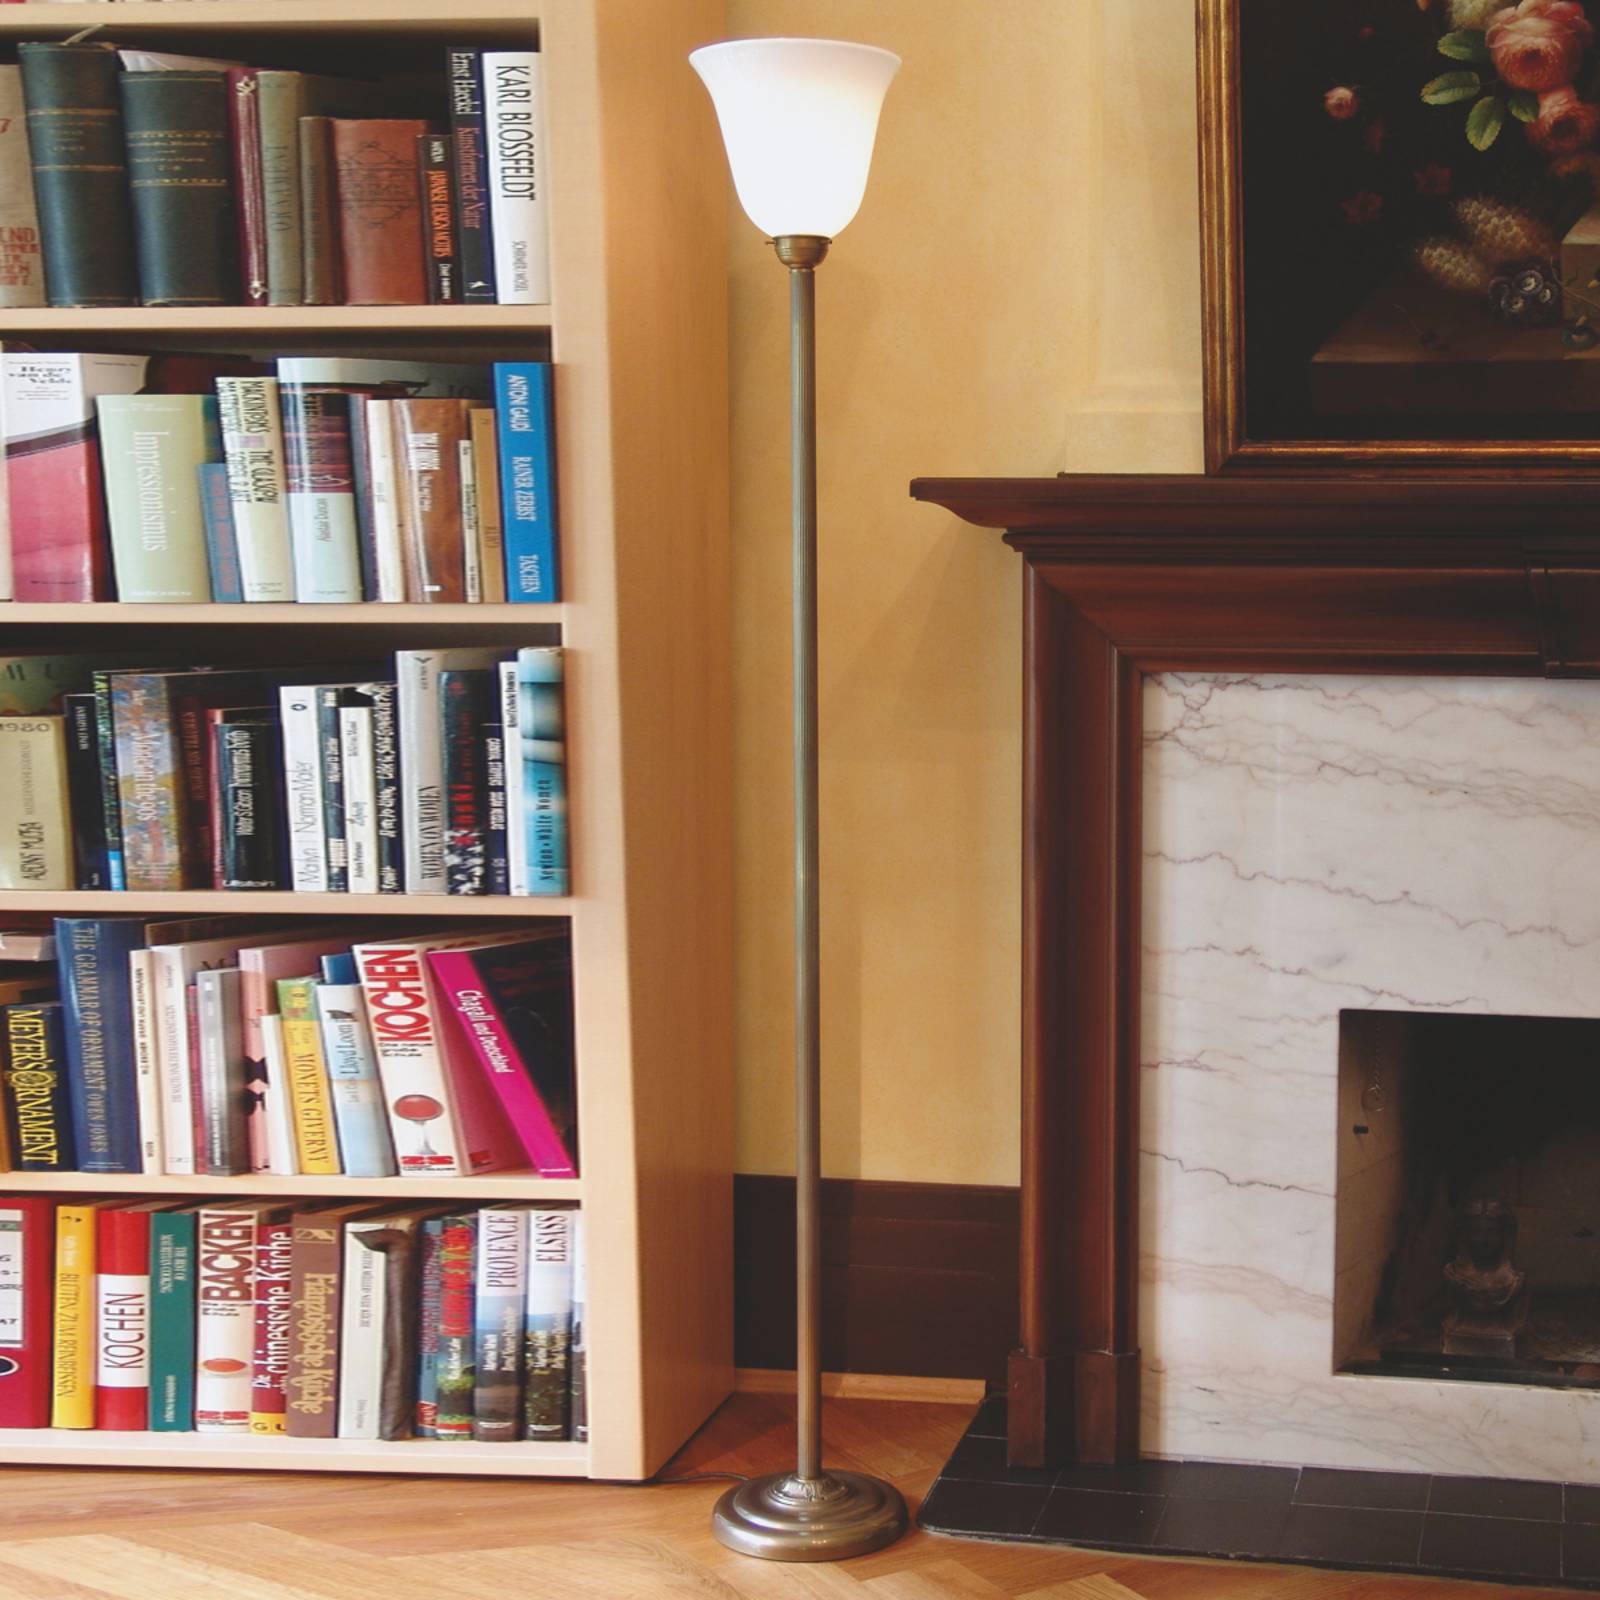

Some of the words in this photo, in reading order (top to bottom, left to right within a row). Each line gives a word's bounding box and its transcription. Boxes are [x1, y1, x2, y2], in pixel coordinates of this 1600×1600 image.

[451, 52, 476, 78] Ernst
[453, 79, 483, 115] Haeckel
[496, 65, 530, 107] KARL
[457, 126, 485, 185] Kunstformen
[497, 112, 536, 201] BLOSSFELDT
[461, 186, 482, 201] der
[432, 202, 451, 230] DESIGN
[463, 201, 486, 229] Natur
[507, 375, 530, 405] ANTONI
[509, 407, 534, 433] GAUDÍ
[512, 456, 535, 489] RAINER
[125, 431, 178, 552] Impressionismus
[514, 490, 537, 522] ZERBST
[517, 555, 541, 593] TASCHEN
[290, 760, 315, 791] Mailer
[417, 785, 442, 824] WOMEN
[535, 779, 552, 811] Women
[293, 793, 318, 834] Norman
[535, 815, 553, 841] White
[419, 825, 443, 840] ON
[419, 845, 445, 880] WOMEN
[538, 849, 555, 881] Newton
[73, 927, 97, 951] THE
[75, 954, 100, 1009] GRAMMAR
[360, 949, 434, 1042] KOCHEN
[78, 1011, 103, 1026] OF
[456, 990, 496, 1022] Chagall
[7, 1009, 56, 1069] MEYER'S
[335, 1024, 357, 1048] Loom
[475, 1022, 494, 1036] und
[80, 1029, 107, 1092] ORNAMENT
[336, 1050, 365, 1074] Lloyd
[479, 1036, 516, 1073] Deutschland
[293, 1053, 322, 1104] MONETS
[6, 1070, 58, 1165] ORNAMENT
[86, 1094, 107, 1121] OWEN
[88, 1123, 110, 1153] JONES
[302, 1108, 329, 1164] GIVERNY
[202, 1210, 253, 1301] BACKEN
[253, 1231, 290, 1283] Küche
[485, 1215, 520, 1289] PROVENCE
[535, 1215, 569, 1263] ELSASS
[103, 1293, 147, 1369] KOCHEN
[253, 1286, 290, 1374] chinesische
[293, 1272, 337, 1367] Französische
[252, 1375, 272, 1389] Die
[289, 1367, 335, 1414] Küche
